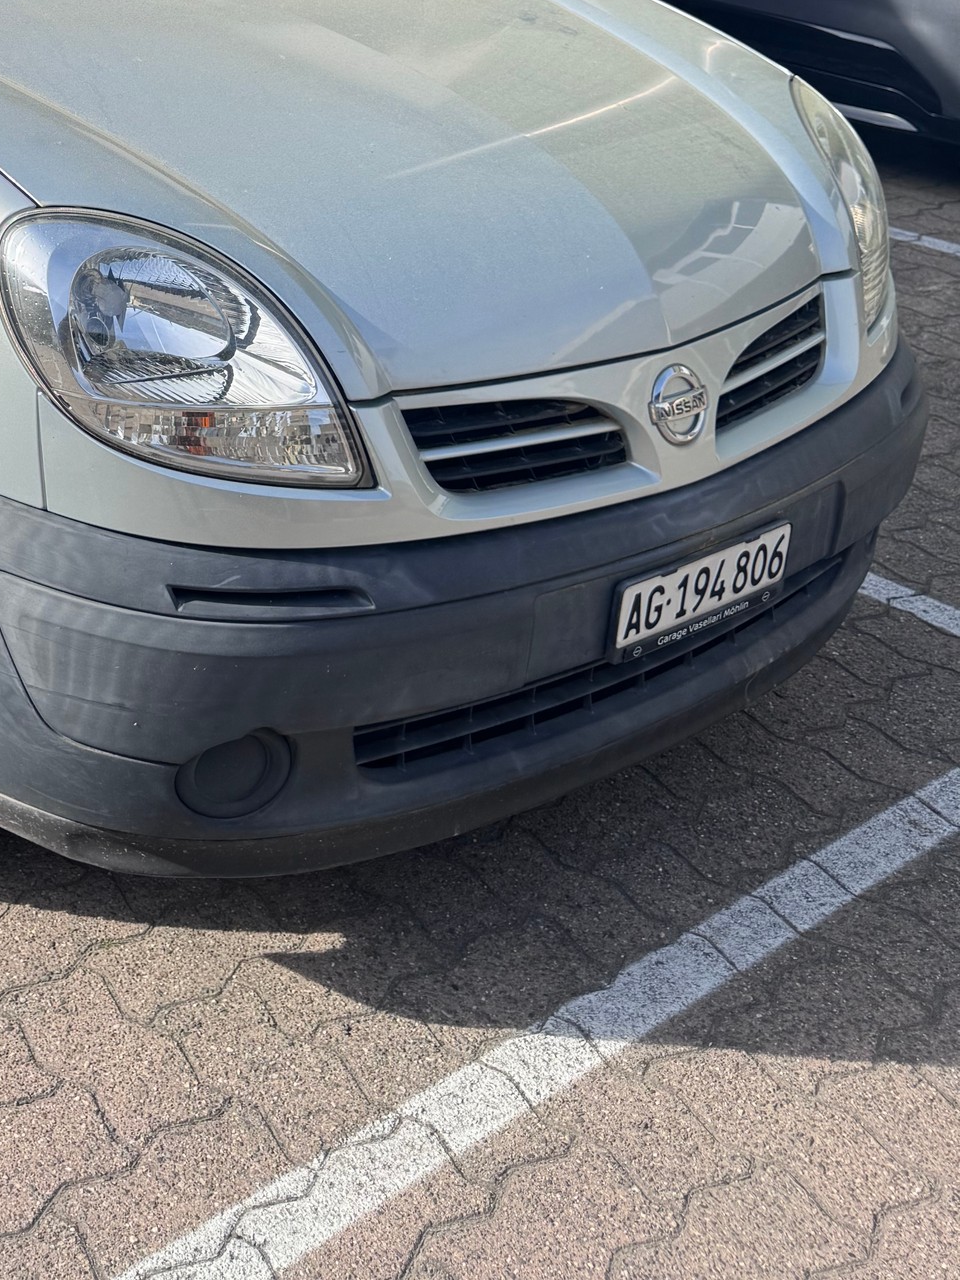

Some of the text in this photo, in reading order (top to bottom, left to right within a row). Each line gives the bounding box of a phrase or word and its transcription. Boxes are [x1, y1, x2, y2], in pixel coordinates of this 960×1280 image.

[659, 392, 706, 420] NISSAN
[731, 533, 786, 595] 806
[657, 600, 750, 646] Garage Vasellari Möhlin
